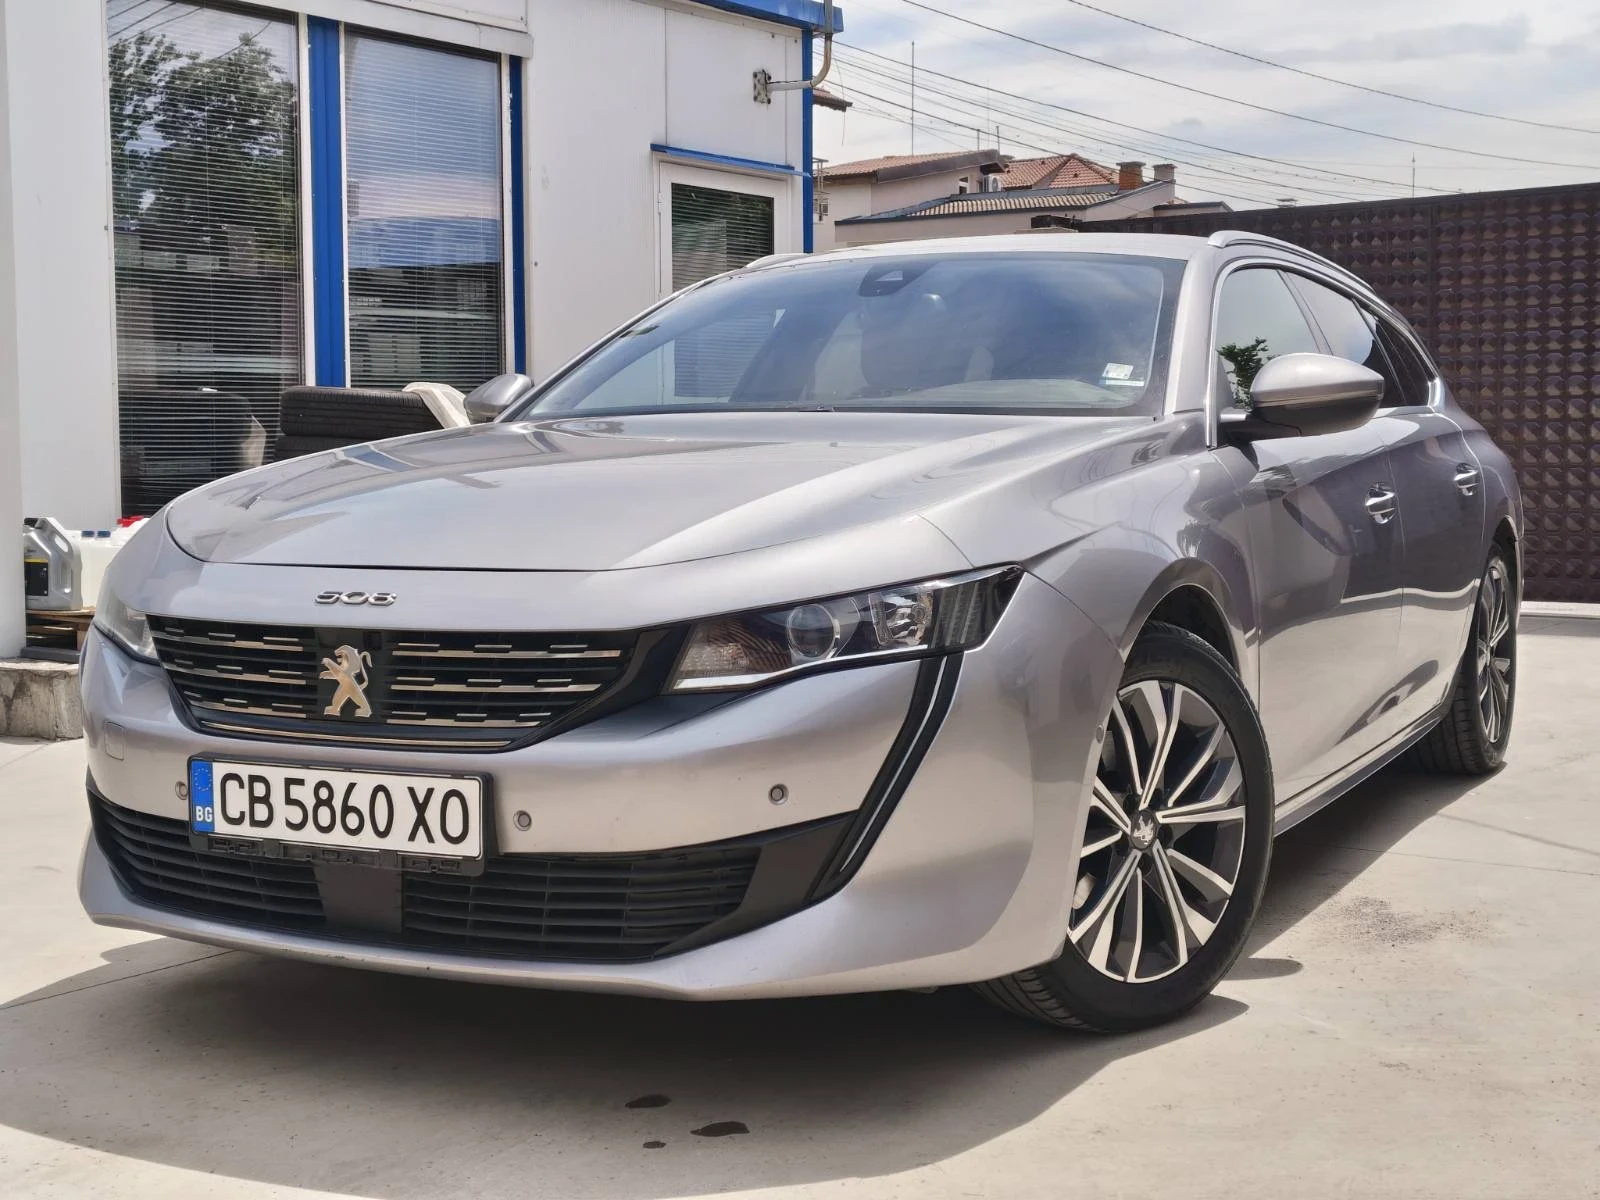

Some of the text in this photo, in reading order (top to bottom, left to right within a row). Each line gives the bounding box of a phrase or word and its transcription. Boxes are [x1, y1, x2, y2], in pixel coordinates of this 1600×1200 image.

[315, 591, 397, 606] 508
[195, 806, 213, 822] BG
[220, 772, 469, 845] CB 5860 XO
